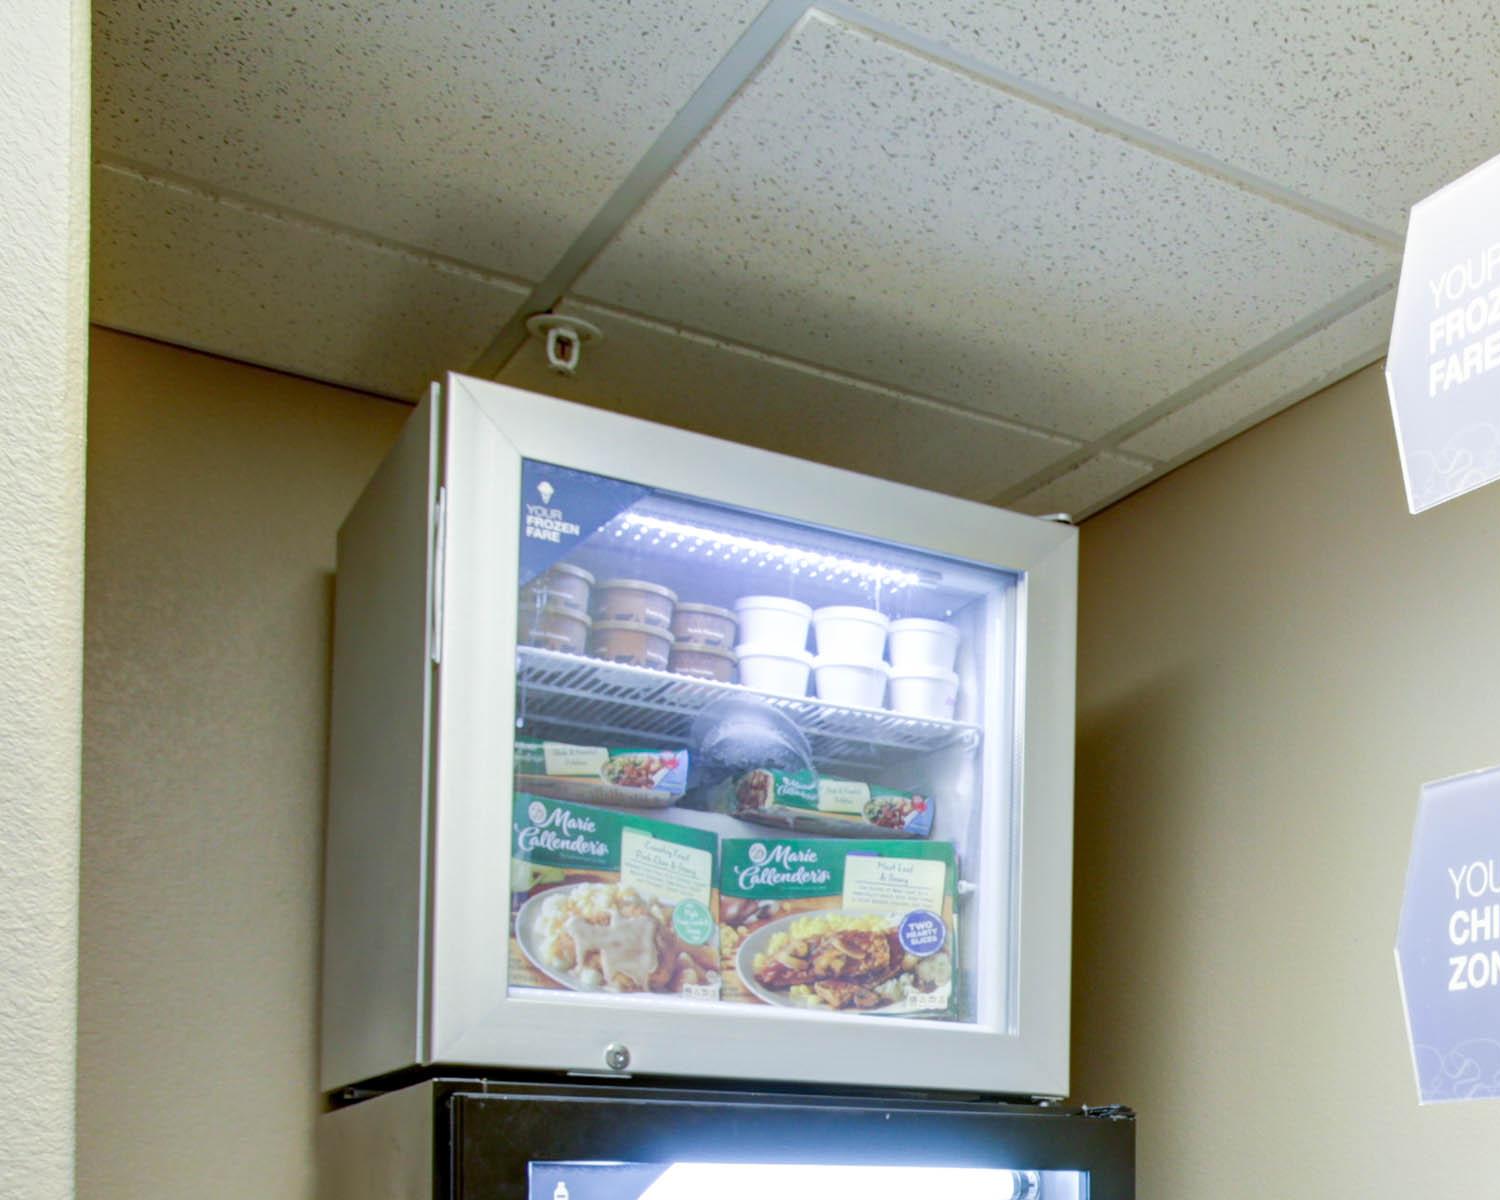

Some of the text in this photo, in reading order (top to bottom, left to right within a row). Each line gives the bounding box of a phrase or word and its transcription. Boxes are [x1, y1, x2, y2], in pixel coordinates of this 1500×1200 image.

[526, 504, 562, 521] YOUR
[526, 515, 580, 536] FROZEN
[526, 526, 560, 543] FARE
[541, 806, 597, 836] Marie
[763, 845, 818, 869] Marie
[908, 922, 933, 932] TWO
